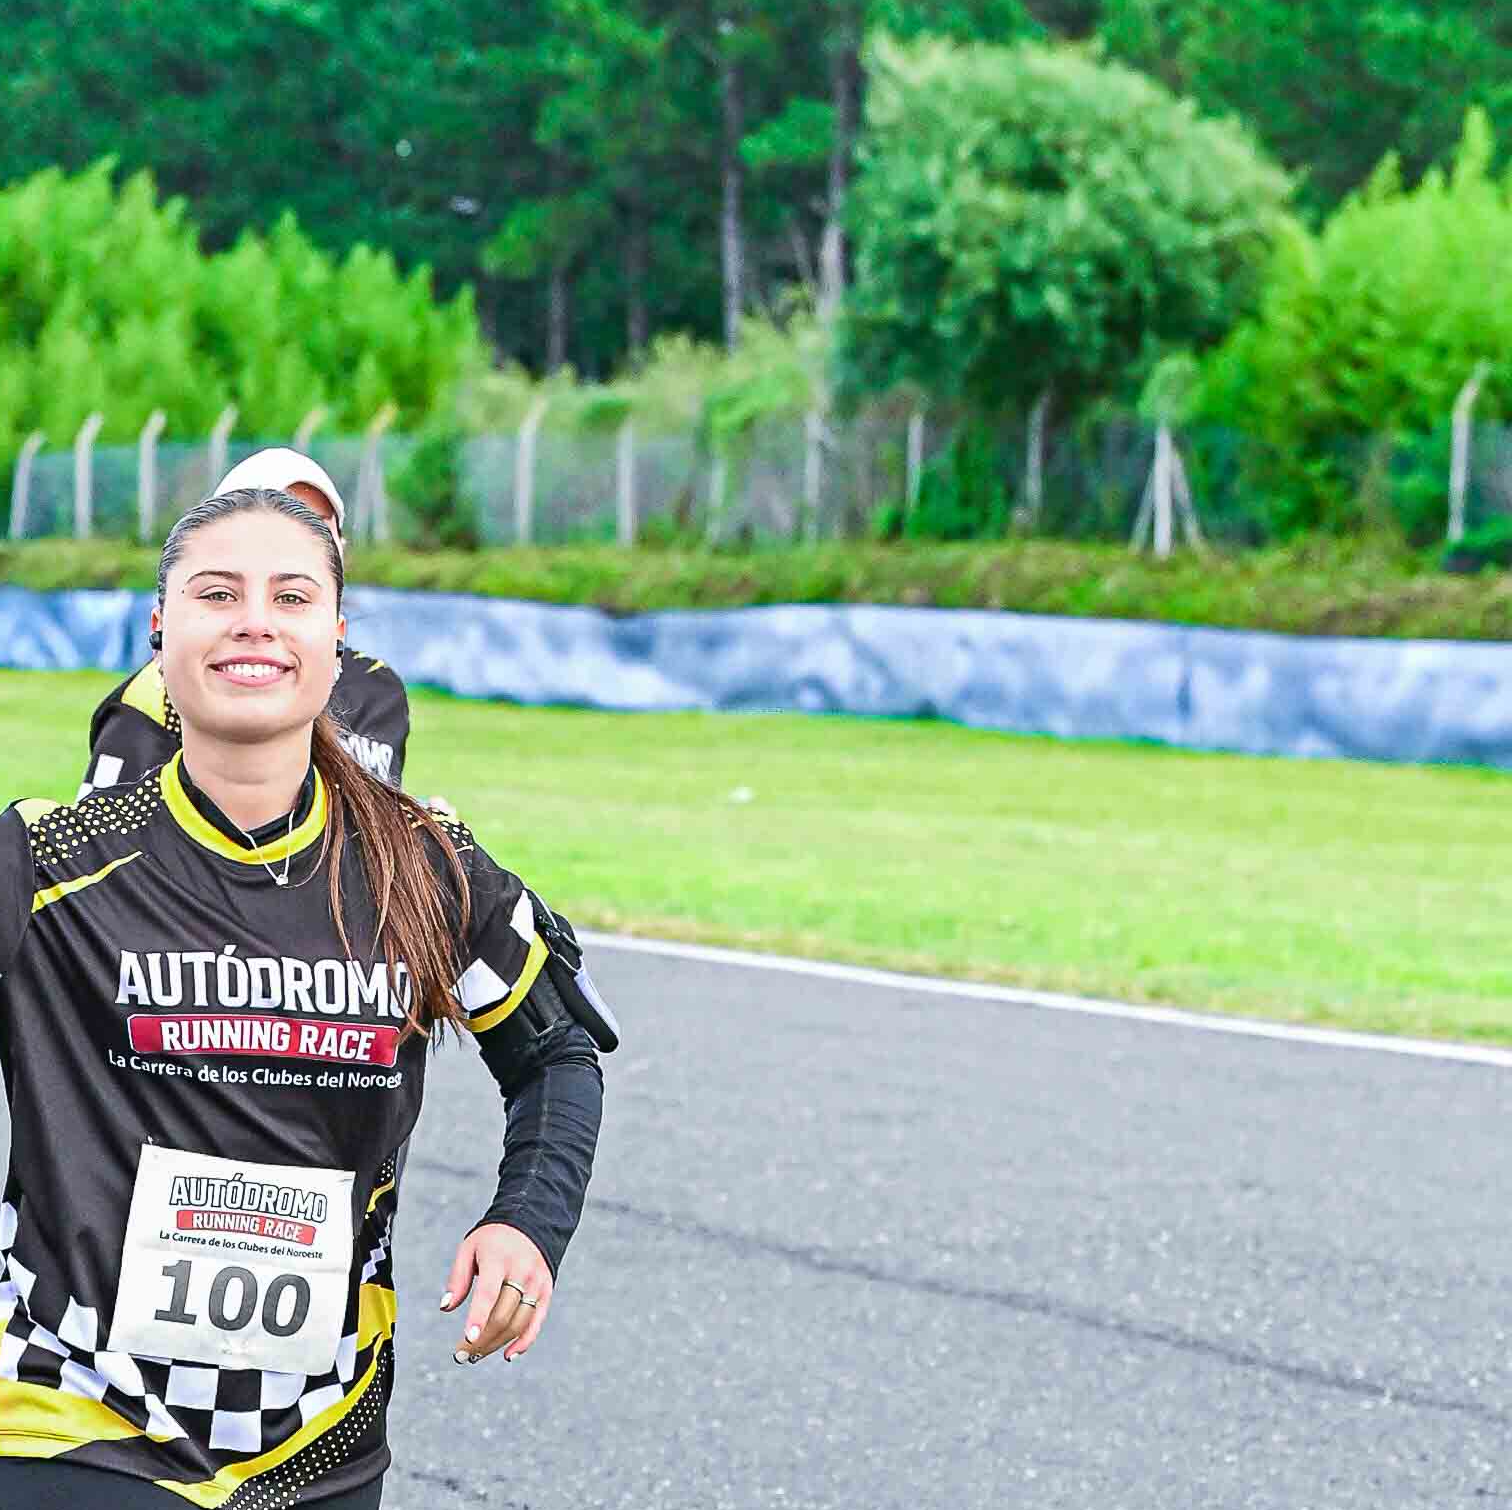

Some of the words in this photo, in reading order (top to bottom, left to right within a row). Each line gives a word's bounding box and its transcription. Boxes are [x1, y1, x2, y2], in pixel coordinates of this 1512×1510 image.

[114, 944, 412, 1019] AUTÓDROMO
[160, 1020, 292, 1053] RUNNING
[299, 1024, 377, 1062] RACE
[108, 1048, 126, 1068] La
[129, 1056, 193, 1078] Carrera
[197, 1064, 220, 1083] de
[222, 1065, 248, 1083] los
[251, 1068, 312, 1086] Clubes
[316, 1071, 344, 1088] del
[169, 1172, 328, 1223] AUTÓDROMO
[159, 1229, 170, 1240] La
[172, 1232, 207, 1245] Carrera
[208, 1237, 221, 1247] de
[222, 1238, 236, 1250] los
[237, 1241, 268, 1254] Clubes
[270, 1245, 285, 1256] del
[286, 1247, 324, 1260] Noroeste
[192, 1211, 261, 1235] RUNNING
[263, 1220, 304, 1243] RACE
[154, 1259, 311, 1337] 100
